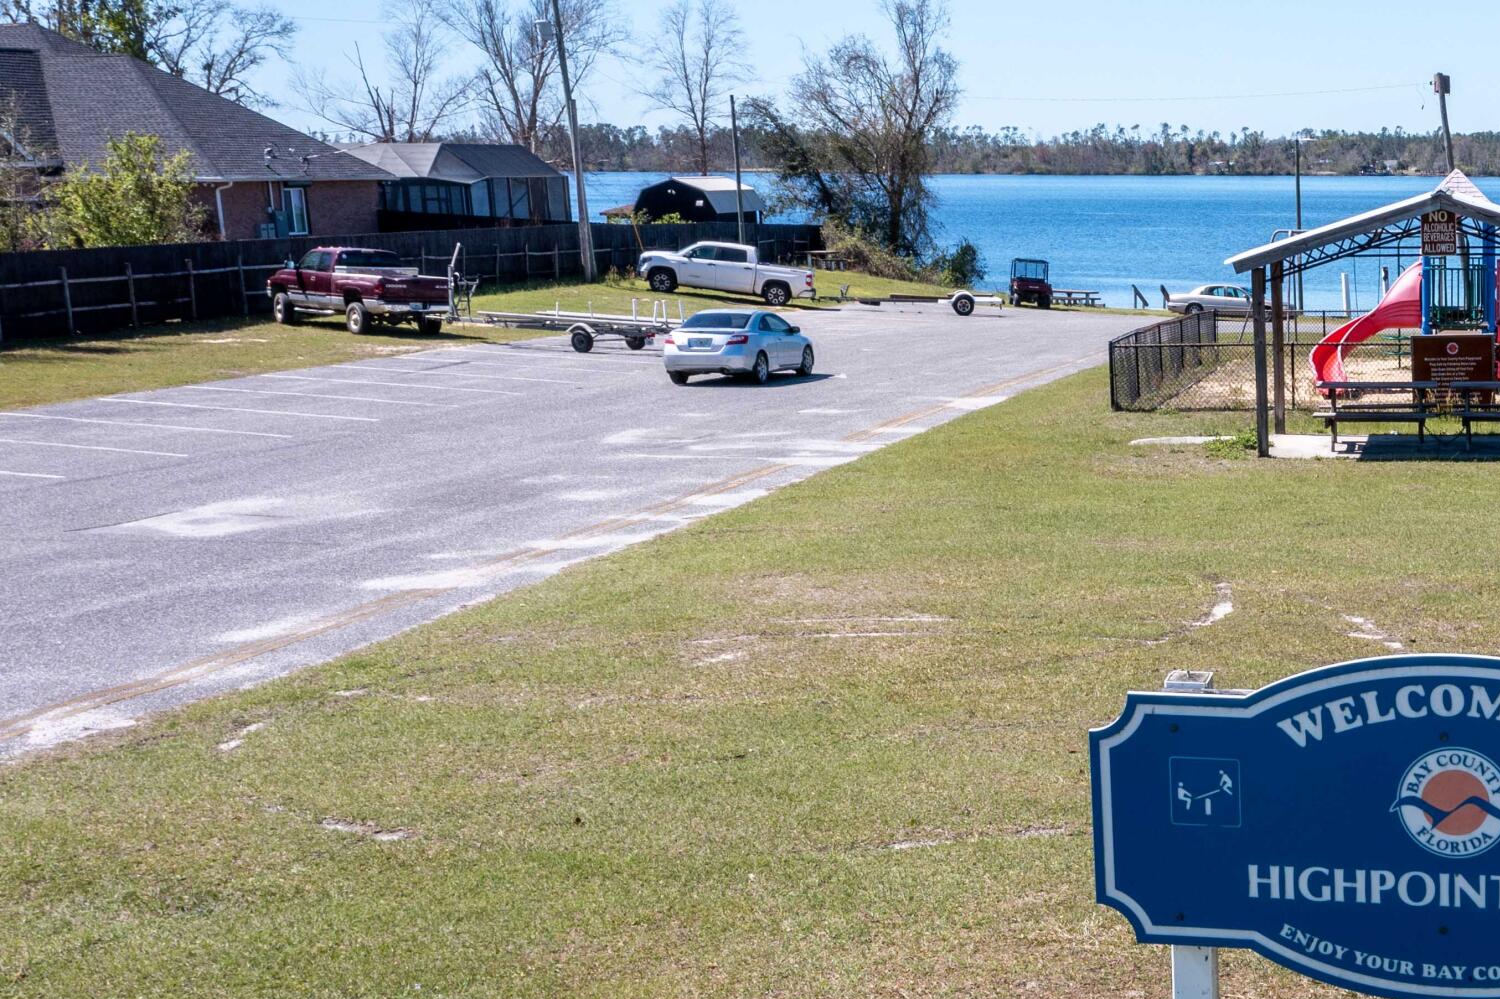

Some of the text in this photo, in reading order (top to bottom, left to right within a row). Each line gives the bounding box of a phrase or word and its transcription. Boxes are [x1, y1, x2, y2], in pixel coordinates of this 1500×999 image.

[1428, 210, 1448, 222] NO
[1423, 222, 1455, 232] ALCOHOLIC
[1423, 232, 1455, 242] BEVERAGES
[1424, 243, 1455, 253] ALLOWED
[1406, 761, 1433, 794] BAY
[1415, 825, 1494, 853] FLORIDA
[1279, 923, 1350, 960] ENJOY
[1353, 950, 1415, 976] YOUR
[1421, 963, 1467, 981] BAY
